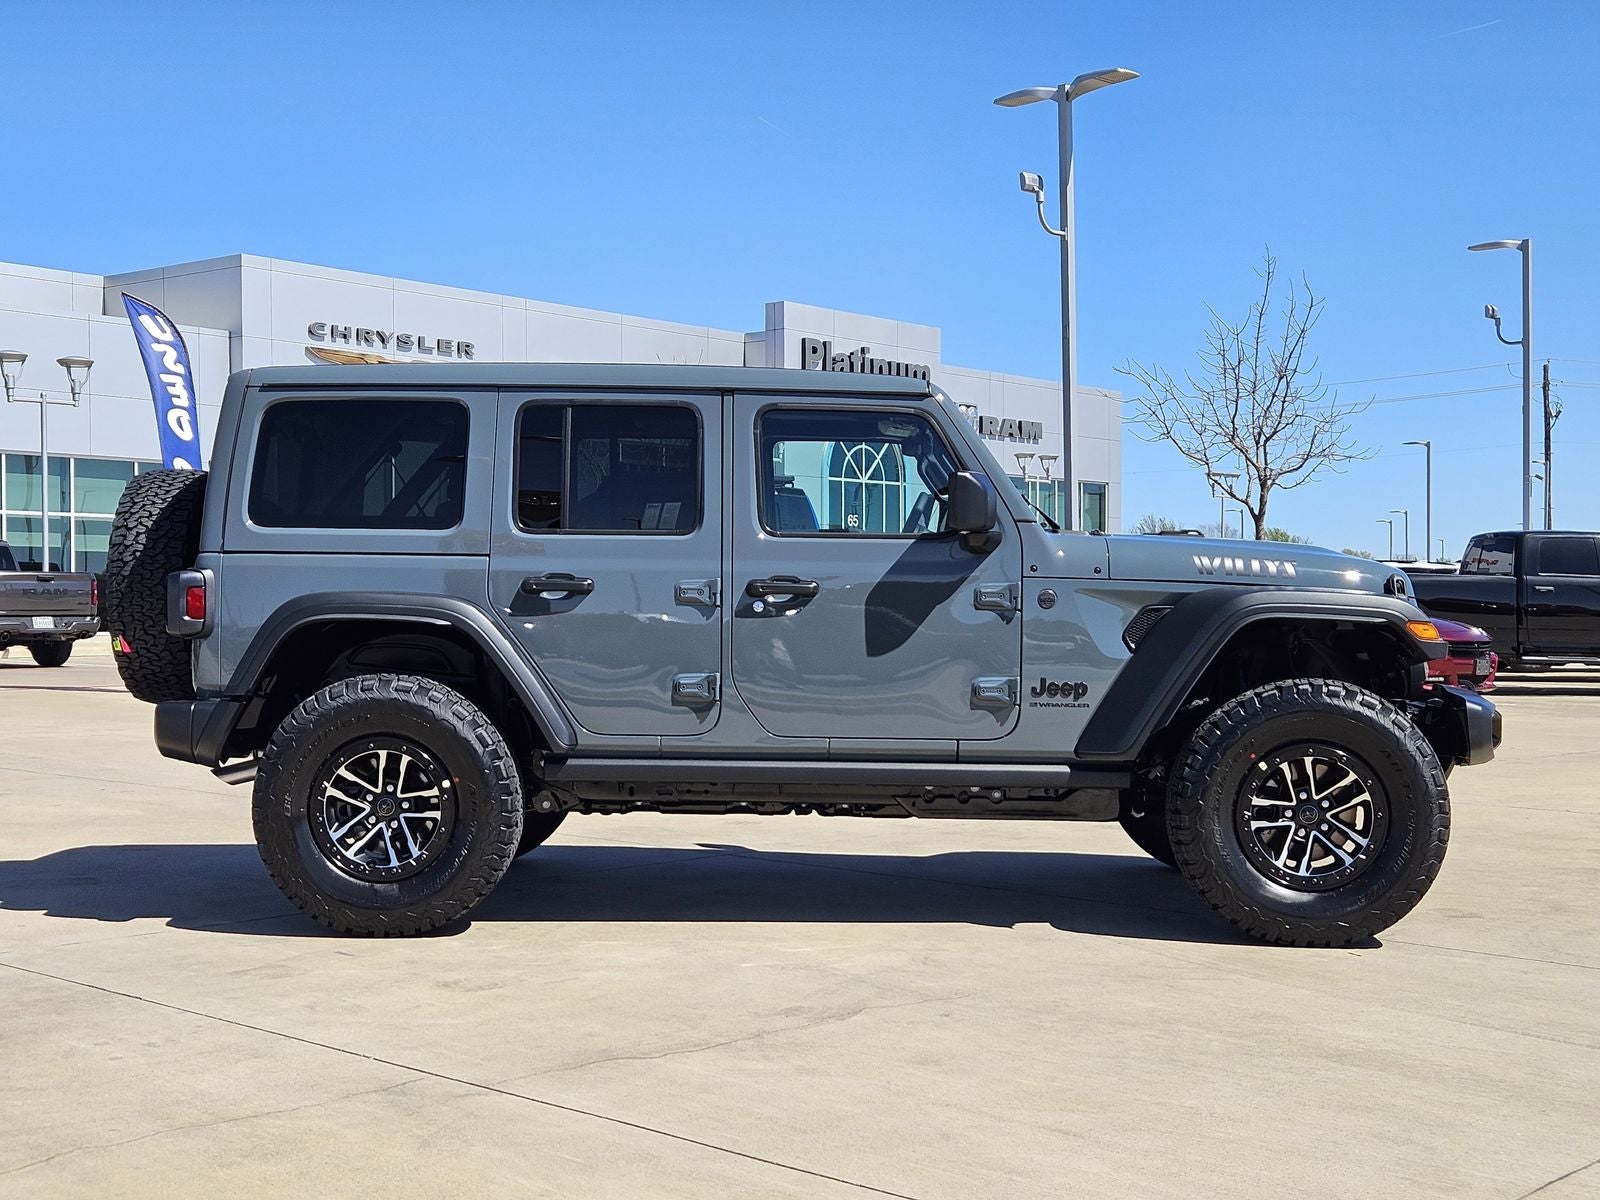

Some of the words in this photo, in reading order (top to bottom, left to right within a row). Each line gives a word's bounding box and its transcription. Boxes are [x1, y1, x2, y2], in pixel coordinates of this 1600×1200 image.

[307, 321, 476, 360] CHRYSLER
[801, 337, 931, 381] Platinum
[979, 415, 1043, 442] RAM
[847, 514, 859, 527] 65
[1192, 554, 1298, 579] WILLYS
[1030, 676, 1088, 702] Jeep
